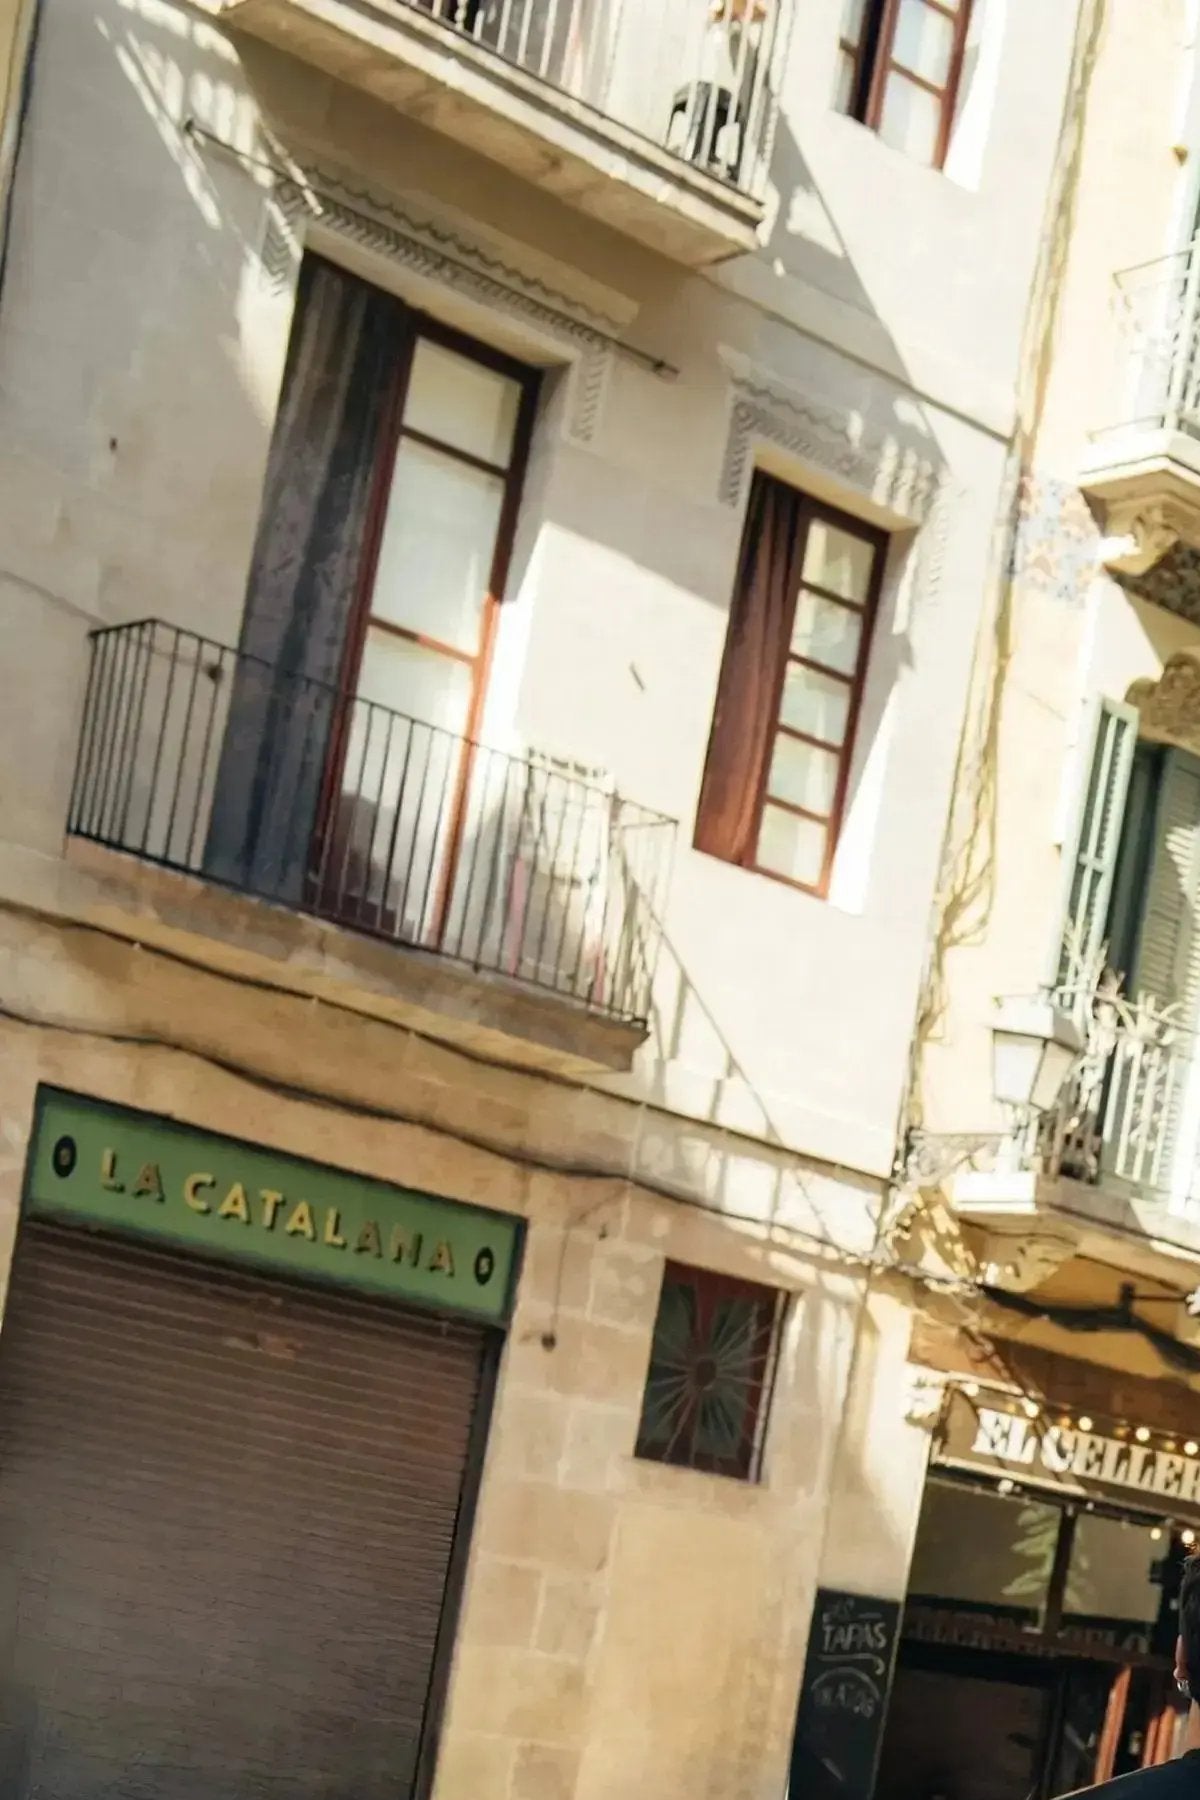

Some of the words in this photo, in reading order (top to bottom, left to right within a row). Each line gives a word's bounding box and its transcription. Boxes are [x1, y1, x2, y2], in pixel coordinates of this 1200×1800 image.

[100, 1148, 166, 1202] LA
[183, 1172, 456, 1278] CATALANA
[971, 1408, 1037, 1464] EL
[822, 1622, 887, 1652] TAPAS
